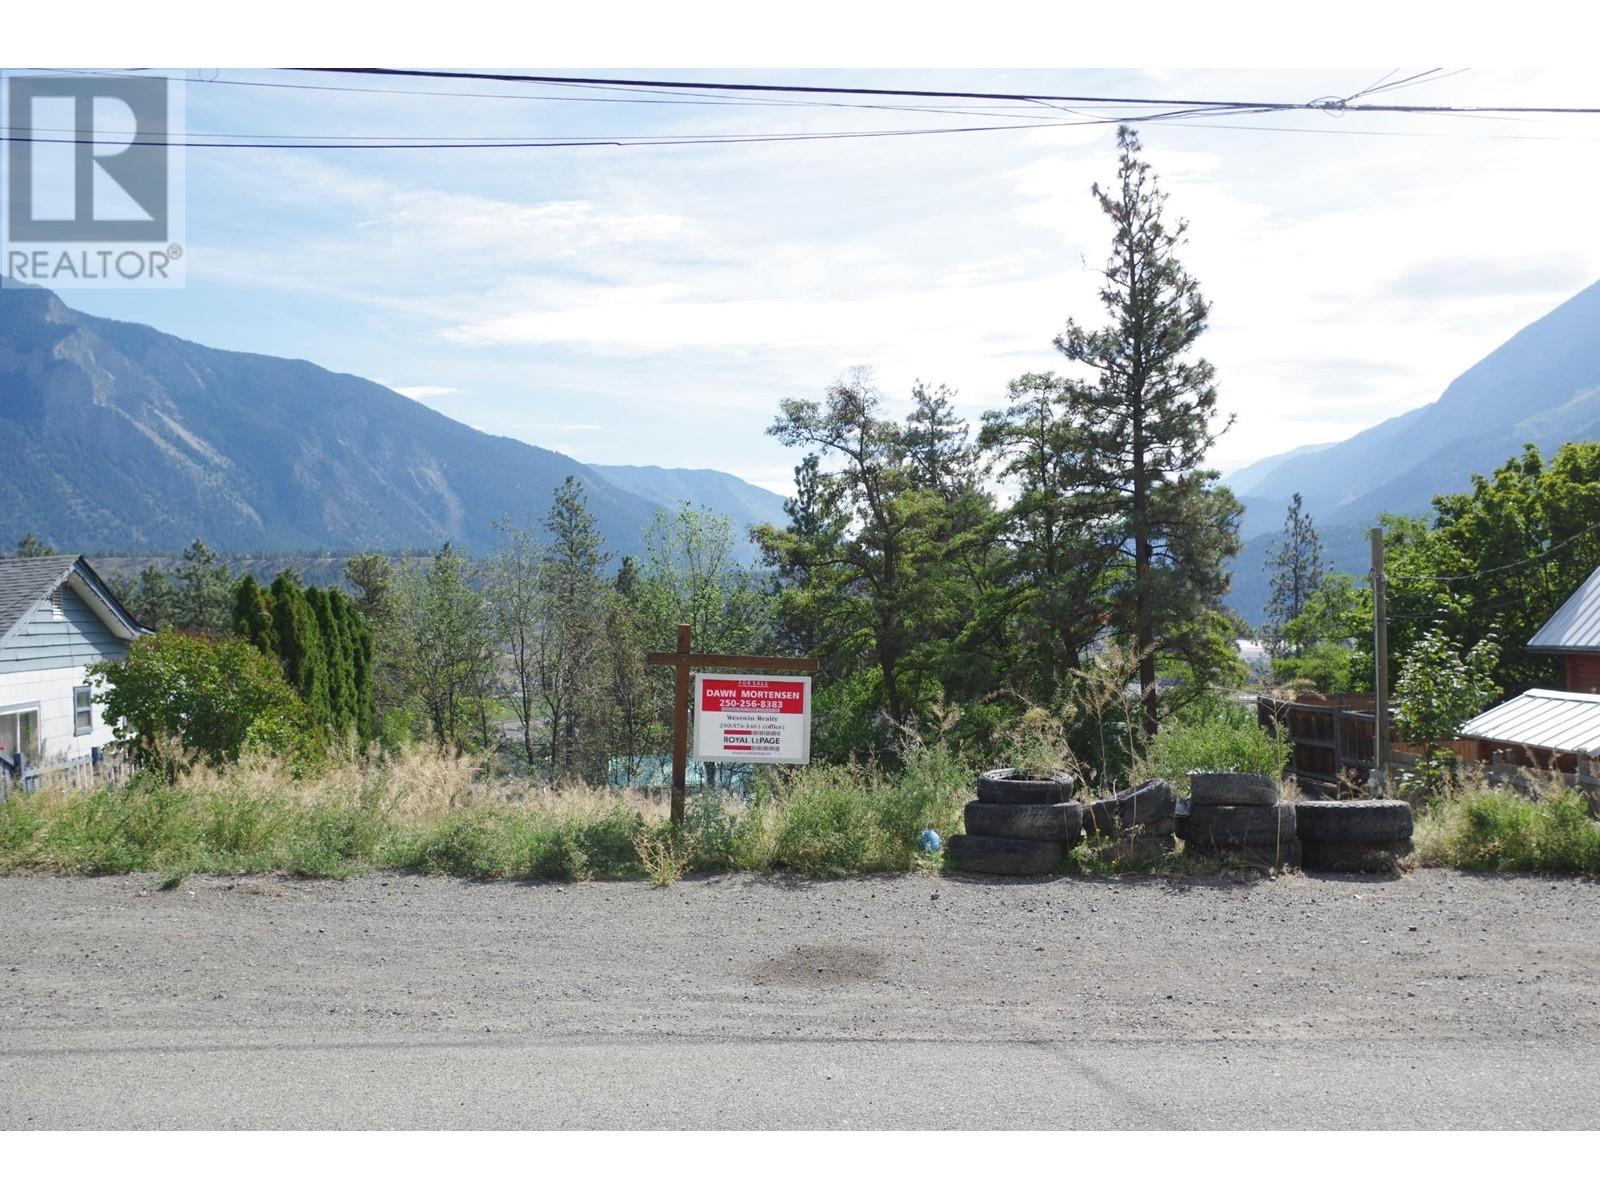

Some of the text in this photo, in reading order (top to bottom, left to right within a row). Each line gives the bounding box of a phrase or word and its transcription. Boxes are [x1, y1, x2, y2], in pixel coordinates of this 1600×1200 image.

[706, 689, 800, 699] DAWN MORTENSEN
[719, 699, 783, 708] 250-256-8383
[723, 736, 748, 744] ROYAL
